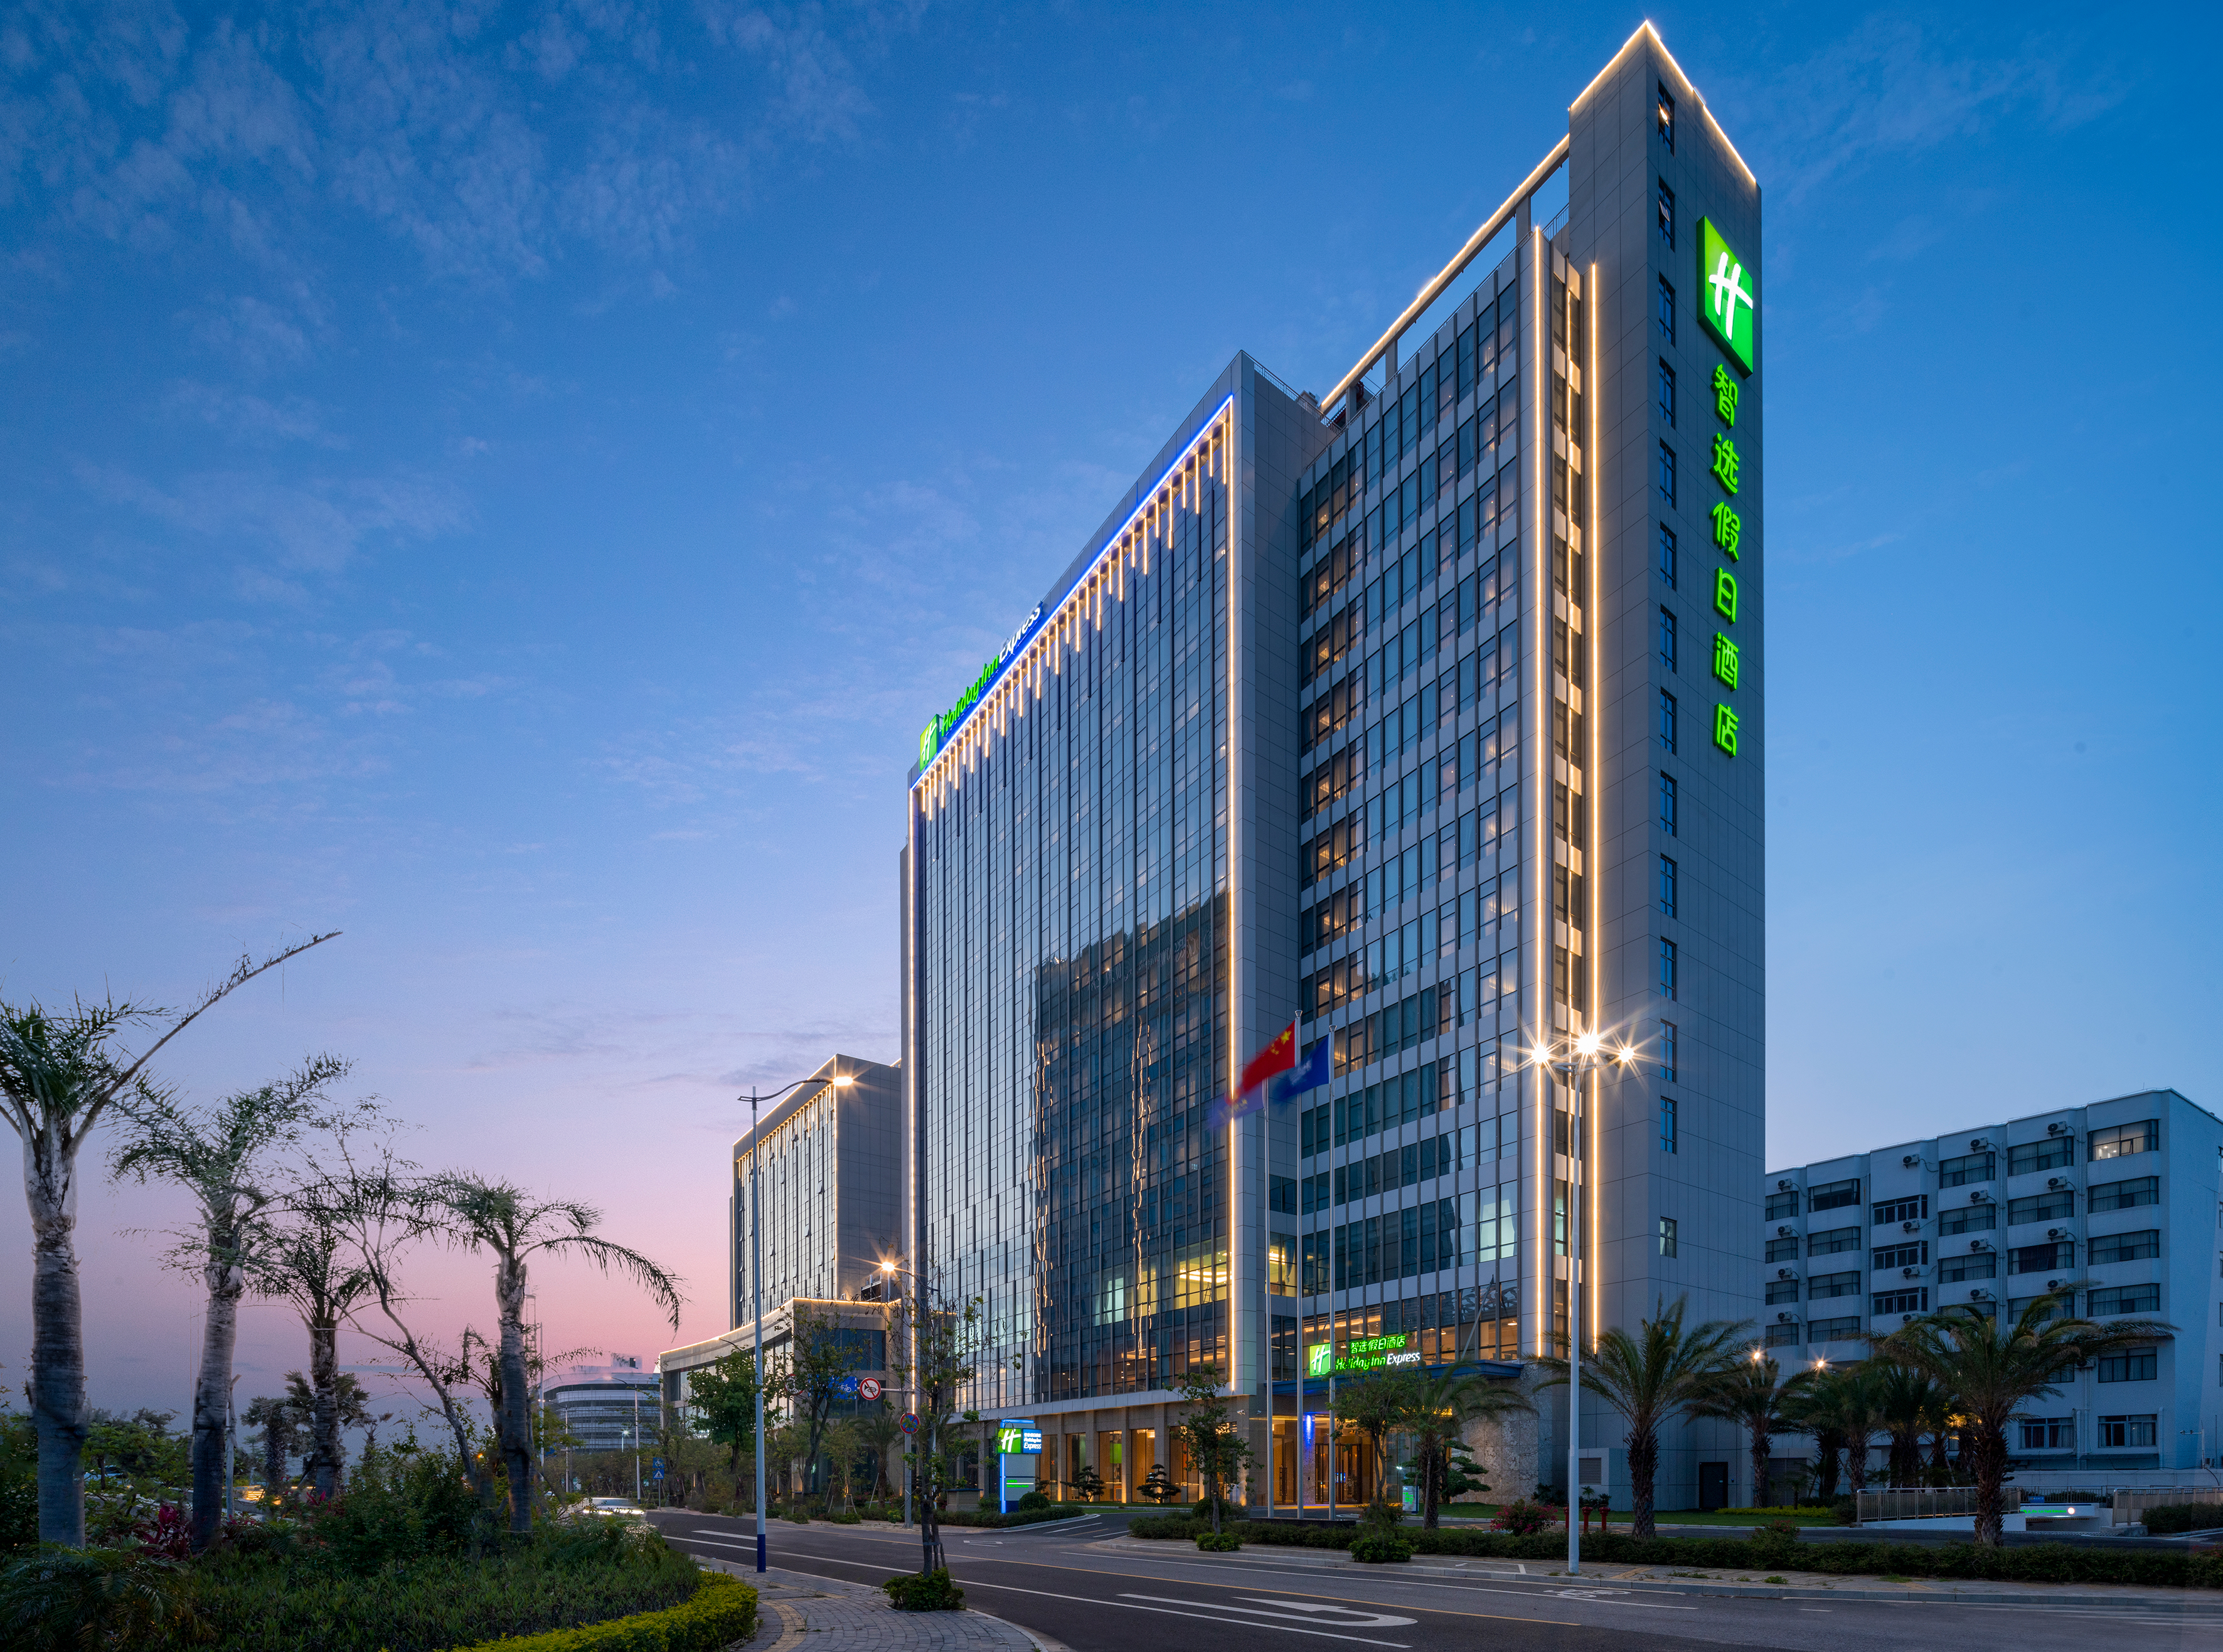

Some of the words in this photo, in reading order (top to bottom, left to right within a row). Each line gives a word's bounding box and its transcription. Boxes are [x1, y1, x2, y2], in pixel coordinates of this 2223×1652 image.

[1711, 364, 1741, 757] 智选假日酒店
[941, 678, 980, 737] Holiday
[981, 654, 999, 687] Inn
[999, 607, 1040, 664] Express
[1350, 1335, 1406, 1354] 智选假日酒店
[1371, 1354, 1386, 1367] Inn
[1387, 1352, 1421, 1366] Express
